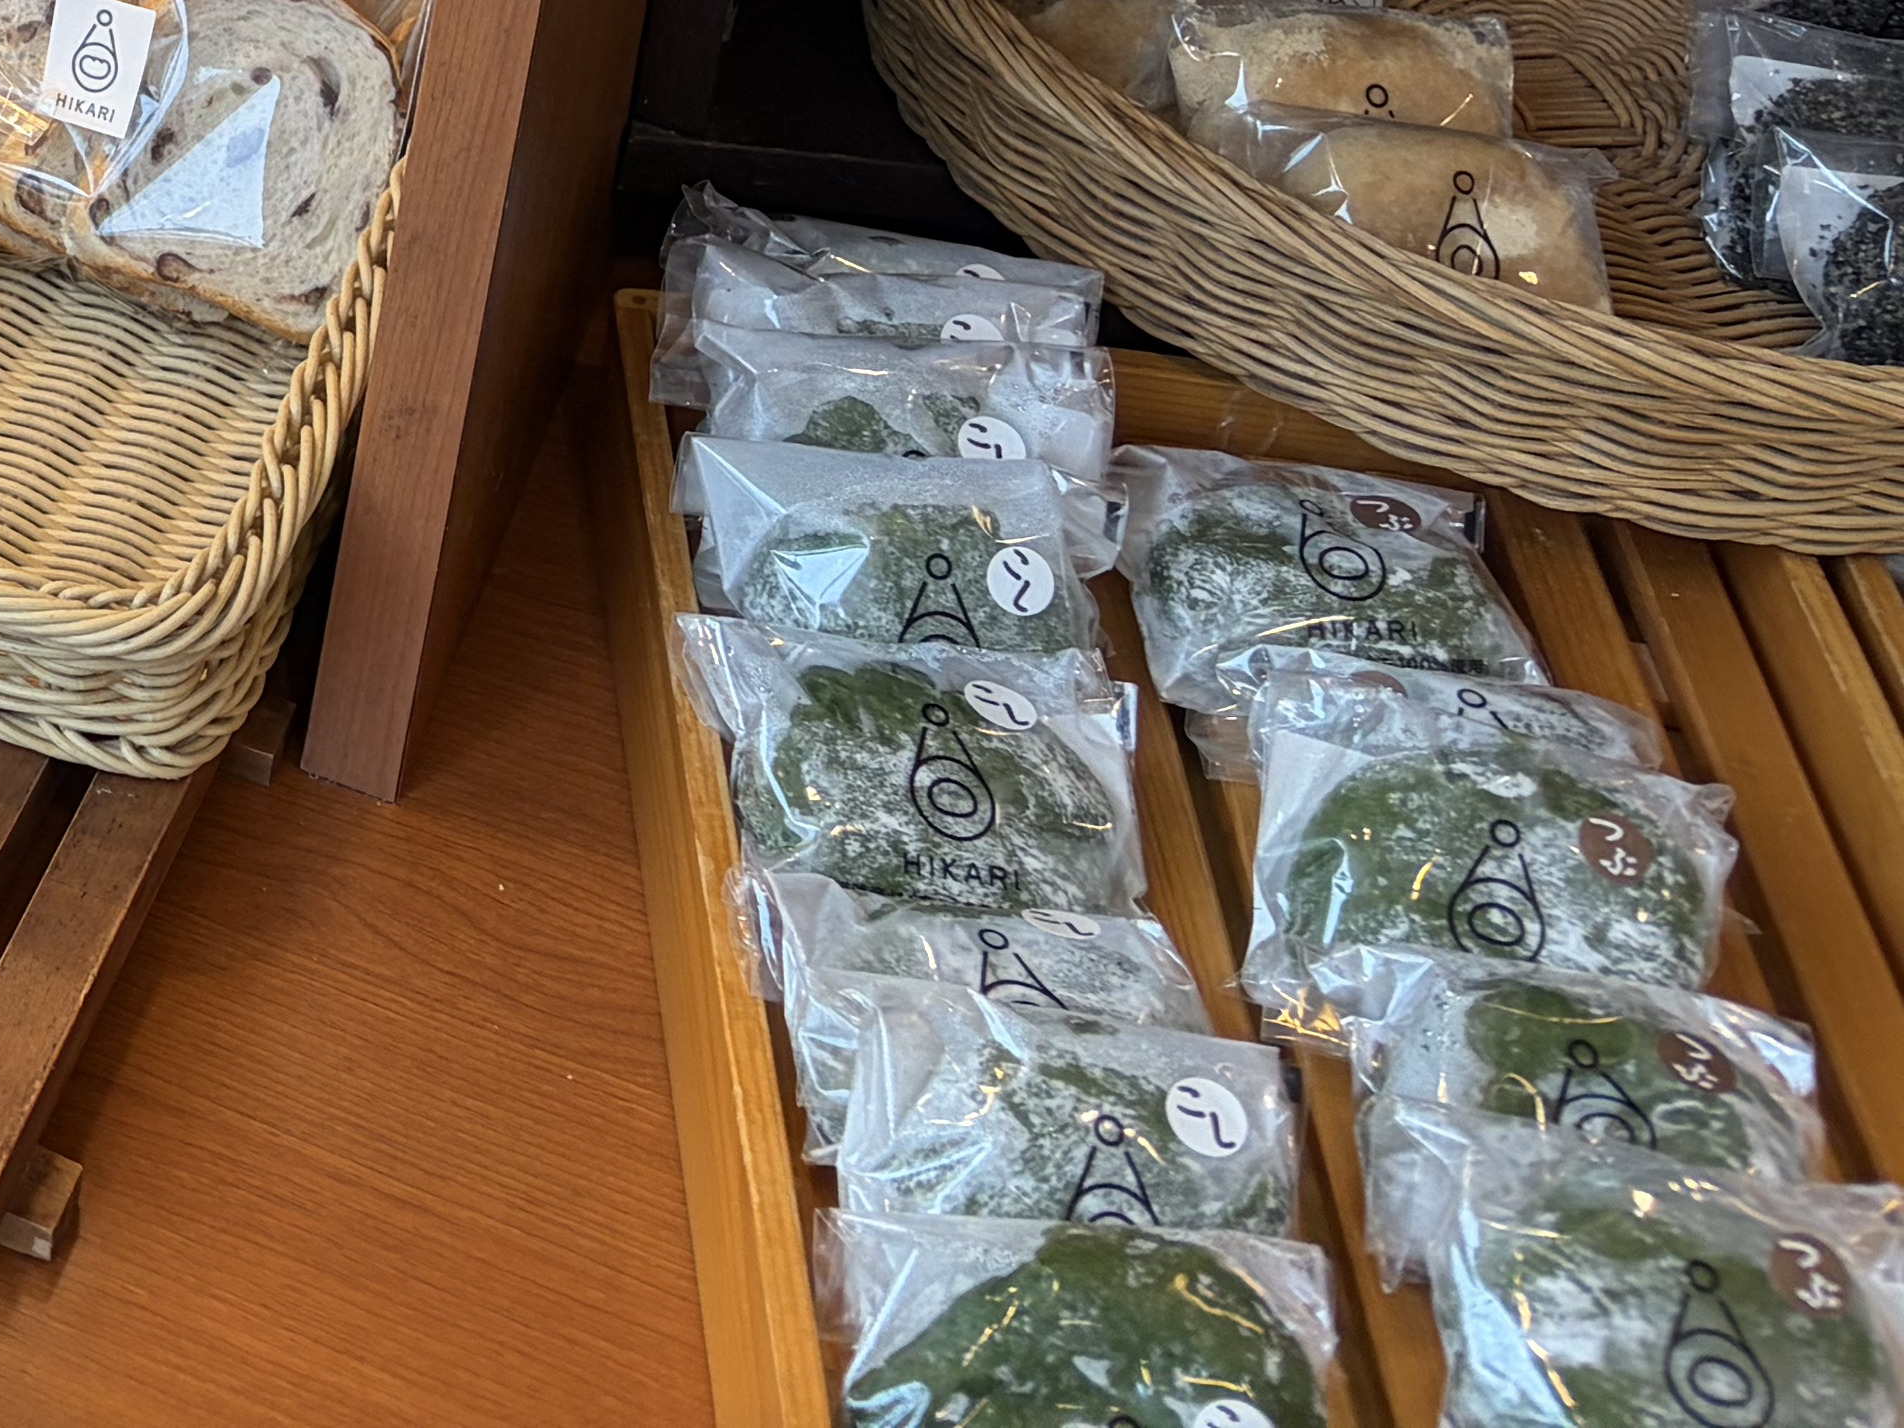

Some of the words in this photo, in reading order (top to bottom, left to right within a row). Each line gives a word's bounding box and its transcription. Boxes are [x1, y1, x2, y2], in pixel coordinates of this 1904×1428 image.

[55, 92, 116, 123] HIKARI
[1306, 618, 1419, 643] HIKARI
[902, 851, 1021, 891] HIKARI
